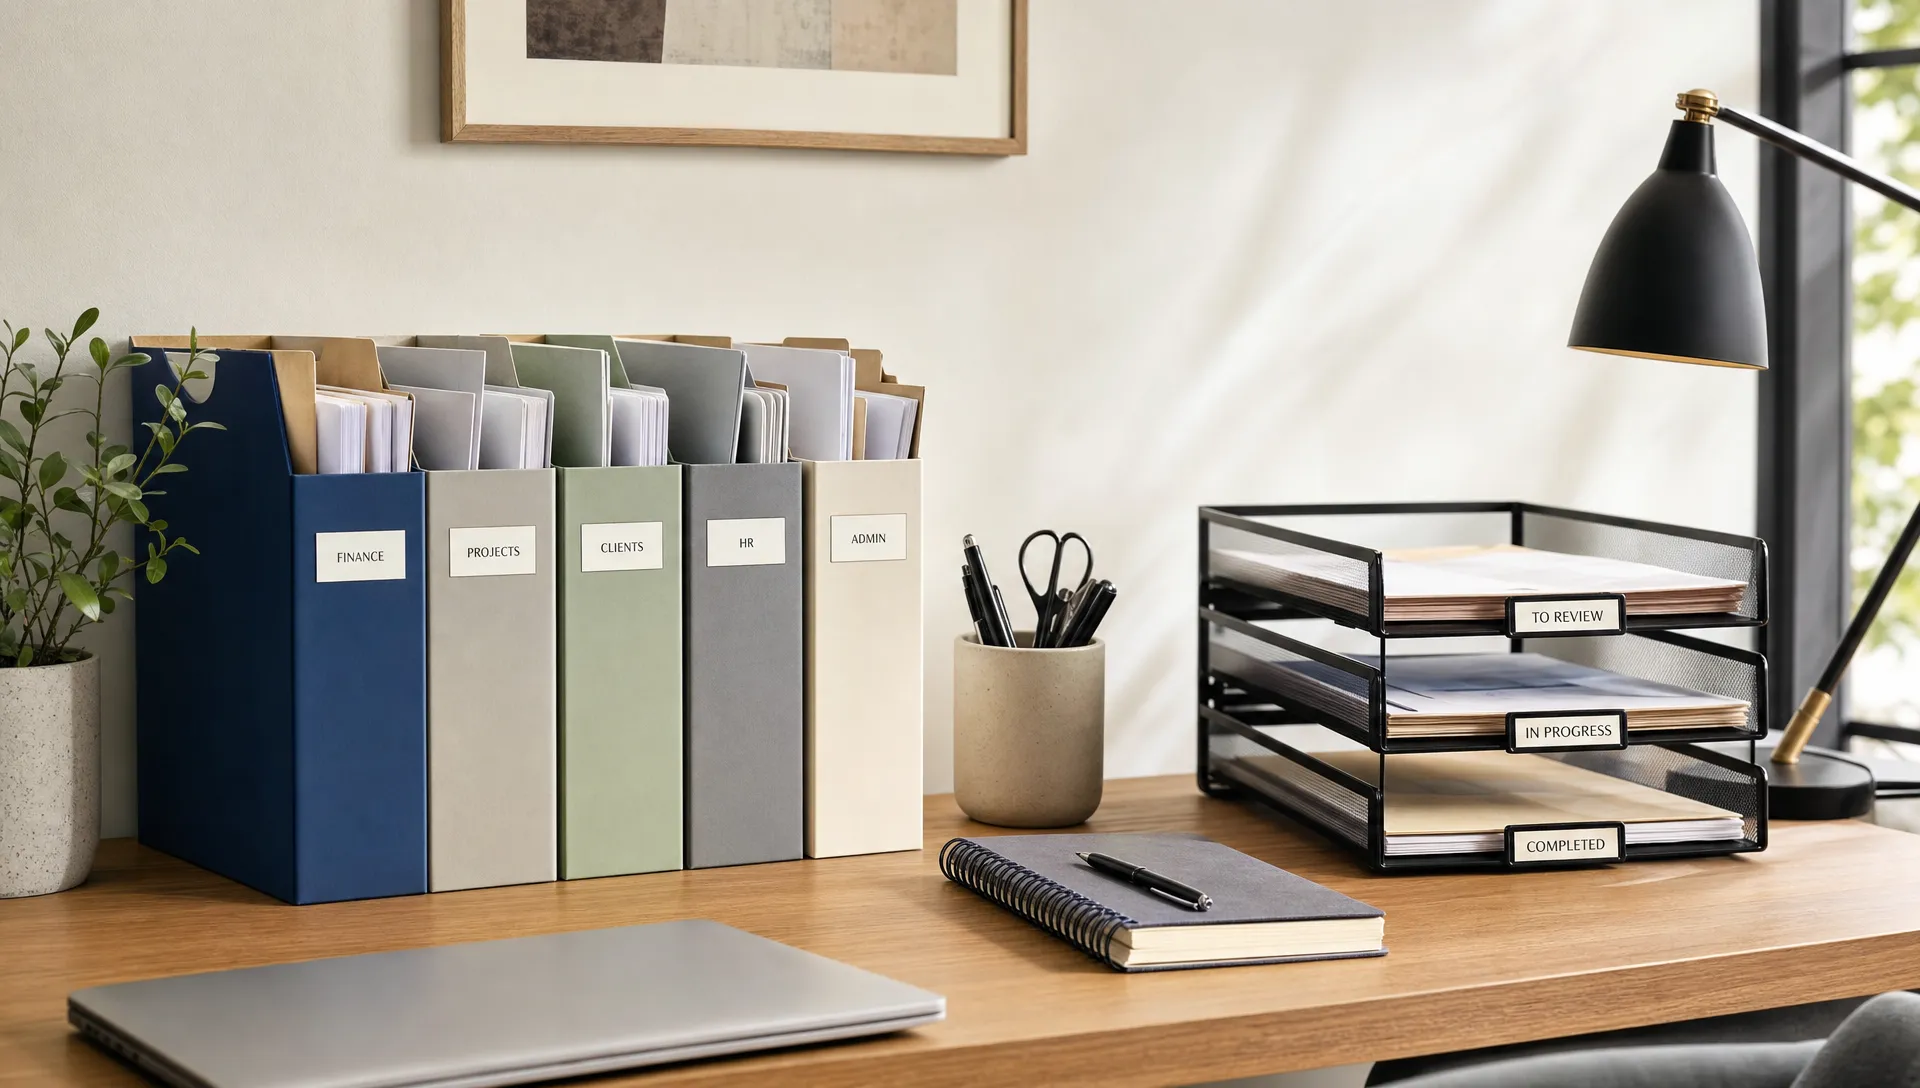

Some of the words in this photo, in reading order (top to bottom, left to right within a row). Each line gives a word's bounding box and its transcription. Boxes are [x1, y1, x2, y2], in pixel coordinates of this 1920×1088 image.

[739, 537, 754, 548] HR
[851, 533, 886, 545] ADMIN
[467, 545, 521, 558] PROJECTS
[600, 541, 644, 554] CLIENTS
[337, 550, 384, 563] FINANCE
[1531, 611, 1550, 624] TO
[1554, 610, 1604, 623] REVIEW
[1525, 726, 1540, 739] IN
[1544, 725, 1612, 739] PROGRESS
[1526, 838, 1605, 853] COMPLETED
